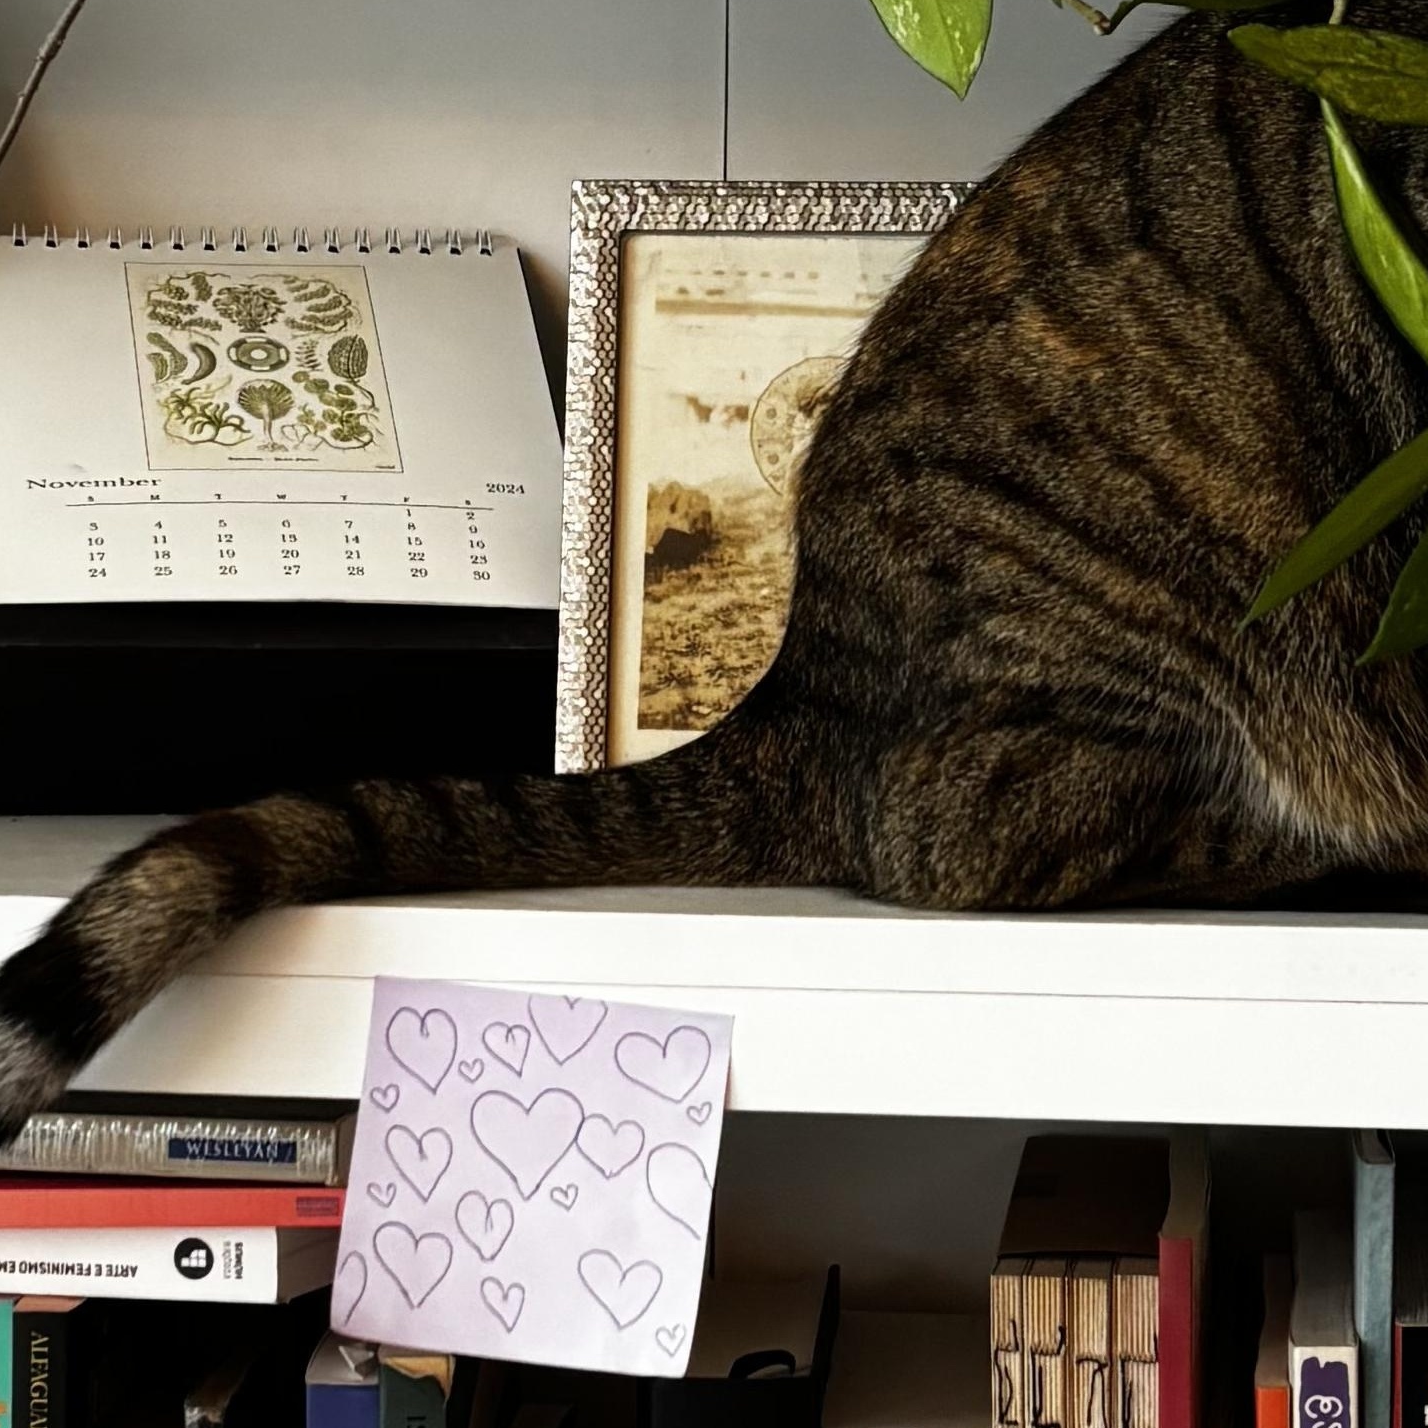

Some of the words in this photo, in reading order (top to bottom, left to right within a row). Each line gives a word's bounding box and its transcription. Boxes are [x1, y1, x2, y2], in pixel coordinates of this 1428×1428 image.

[25, 477, 161, 490] November
[486, 482, 525, 495] 2024
[88, 567, 107, 579] 24
[153, 566, 173, 578] 25
[283, 565, 301, 578] 27
